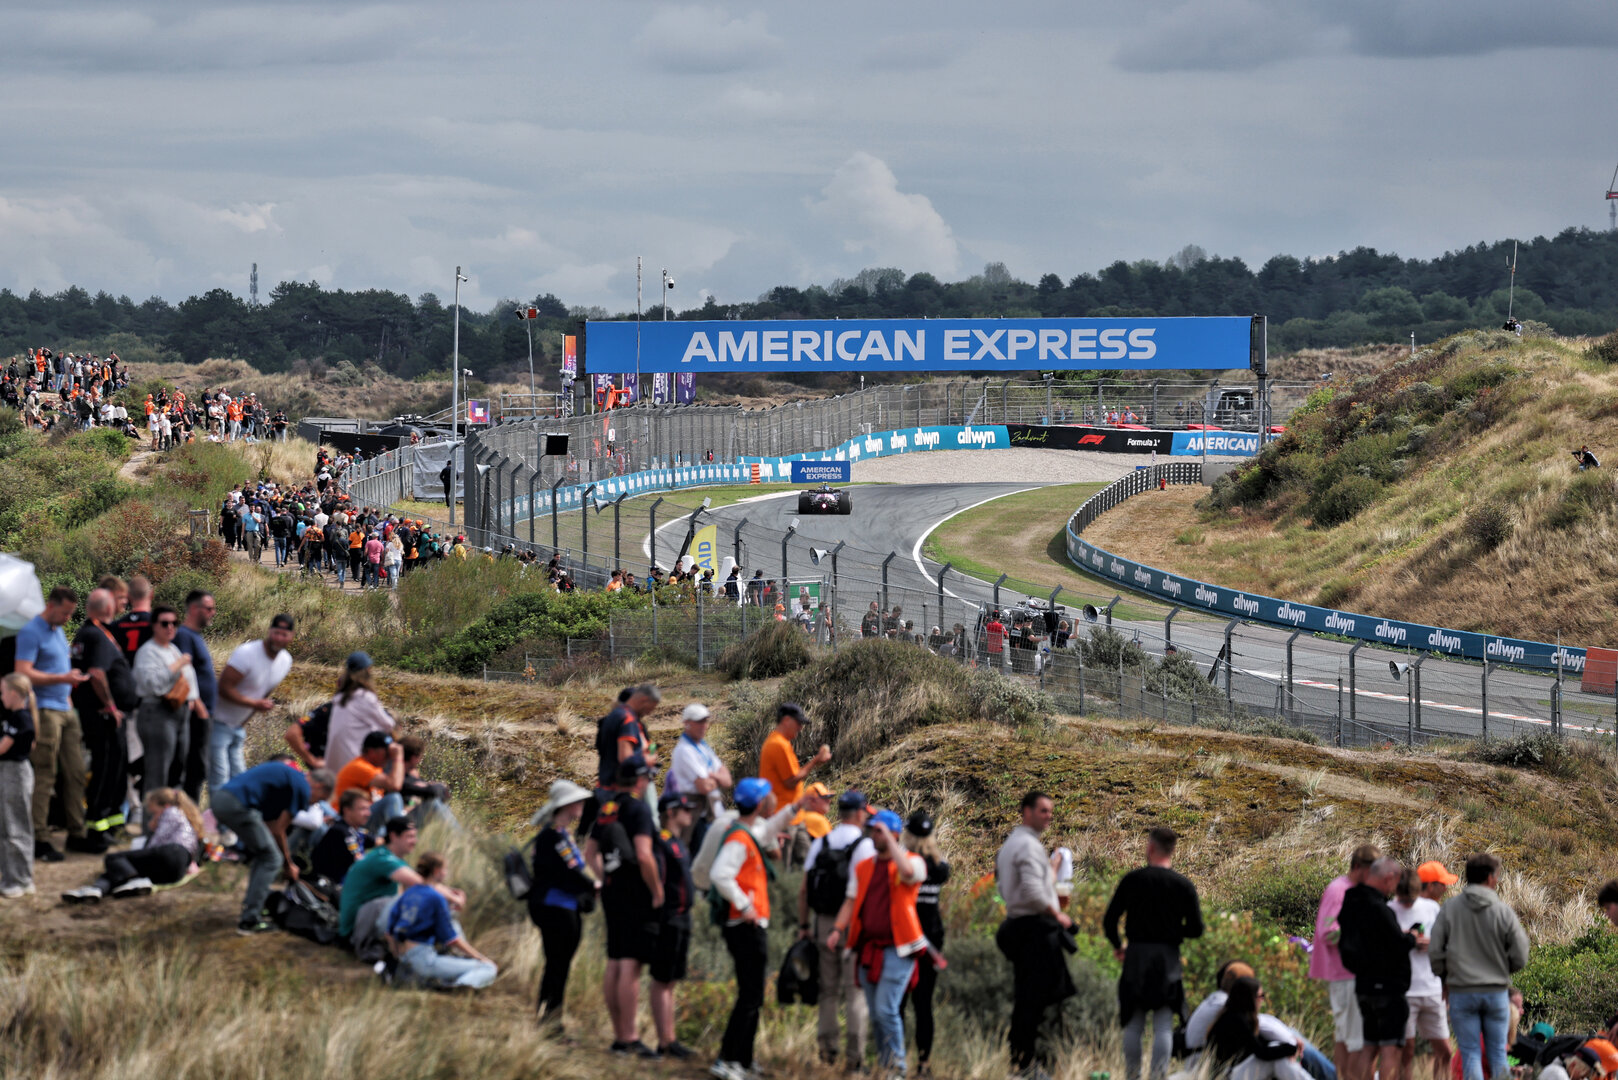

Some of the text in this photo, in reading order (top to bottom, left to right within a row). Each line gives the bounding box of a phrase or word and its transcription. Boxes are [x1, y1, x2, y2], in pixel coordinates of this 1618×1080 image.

[681, 328, 1157, 362] AMERICAN EXPRESS
[957, 427, 996, 449] allwyn
[1077, 434, 1106, 445] F1
[1127, 438, 1152, 447] Formula
[1186, 437, 1257, 452] AMERICAN
[800, 466, 842, 474] AMERICAN
[699, 541, 712, 569] AID
[1162, 575, 1182, 596] allwyn
[1195, 584, 1218, 606] allwyn
[1233, 593, 1259, 616] allwyn
[1277, 602, 1306, 624] allwyn
[1325, 611, 1355, 635] allwyn
[1375, 620, 1407, 645] allwyn
[126, 630, 140, 651] 1
[1428, 629, 1461, 653] allwyn
[1487, 638, 1525, 663] allwyn
